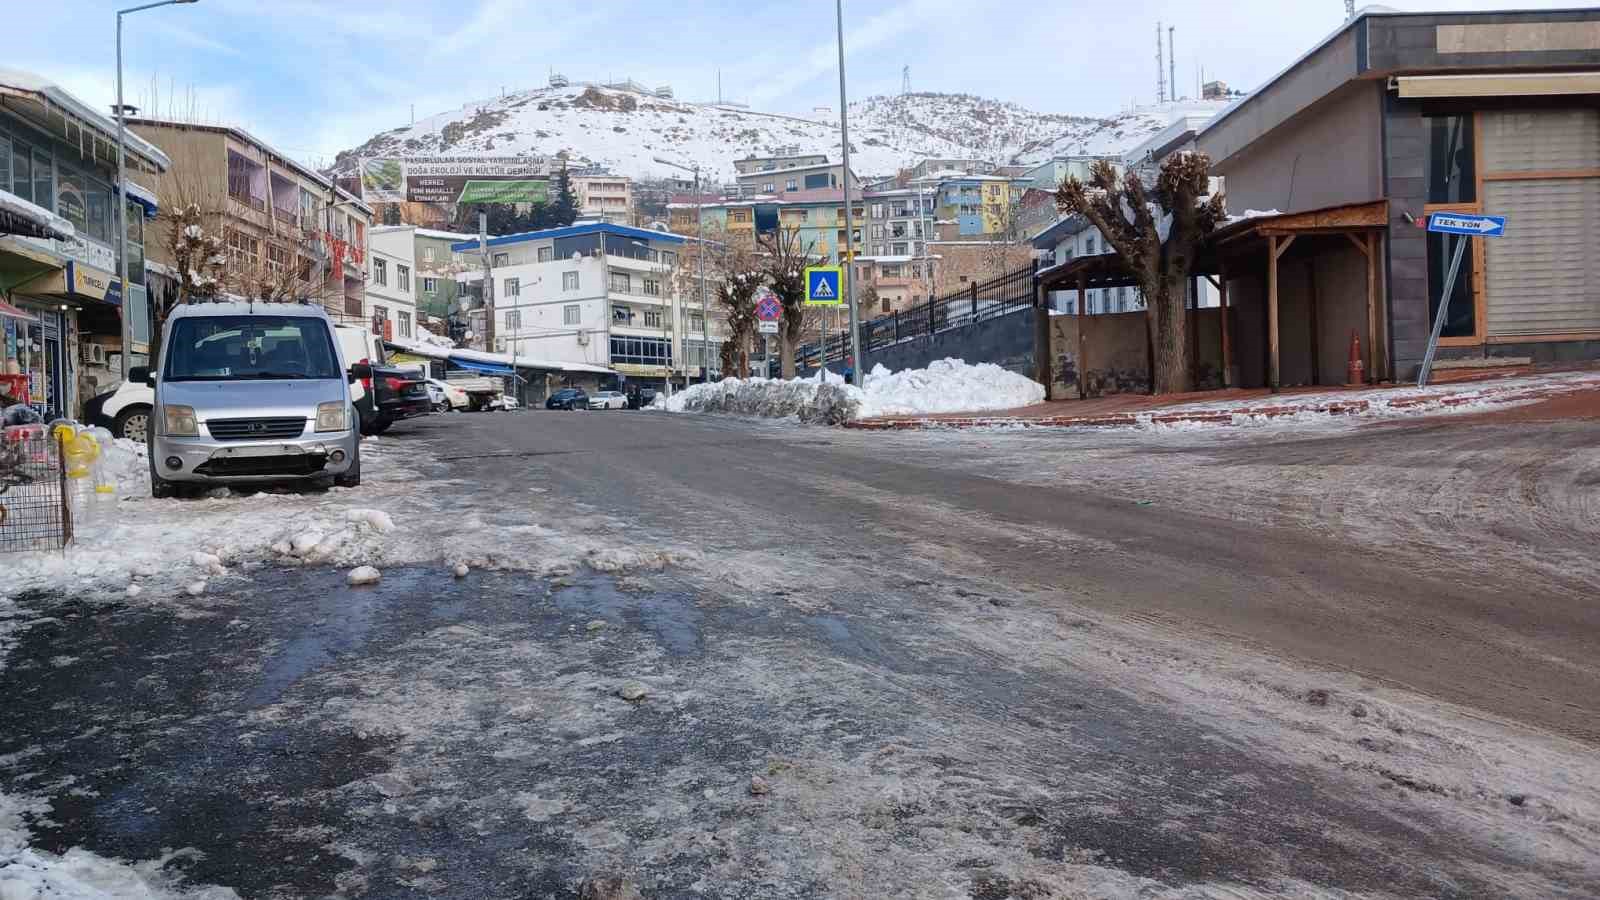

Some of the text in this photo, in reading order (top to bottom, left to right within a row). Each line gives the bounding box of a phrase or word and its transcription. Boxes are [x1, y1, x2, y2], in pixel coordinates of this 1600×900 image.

[407, 166, 428, 175] DOĞA
[463, 167, 473, 175] VE
[475, 165, 505, 175] KÜLTÜR
